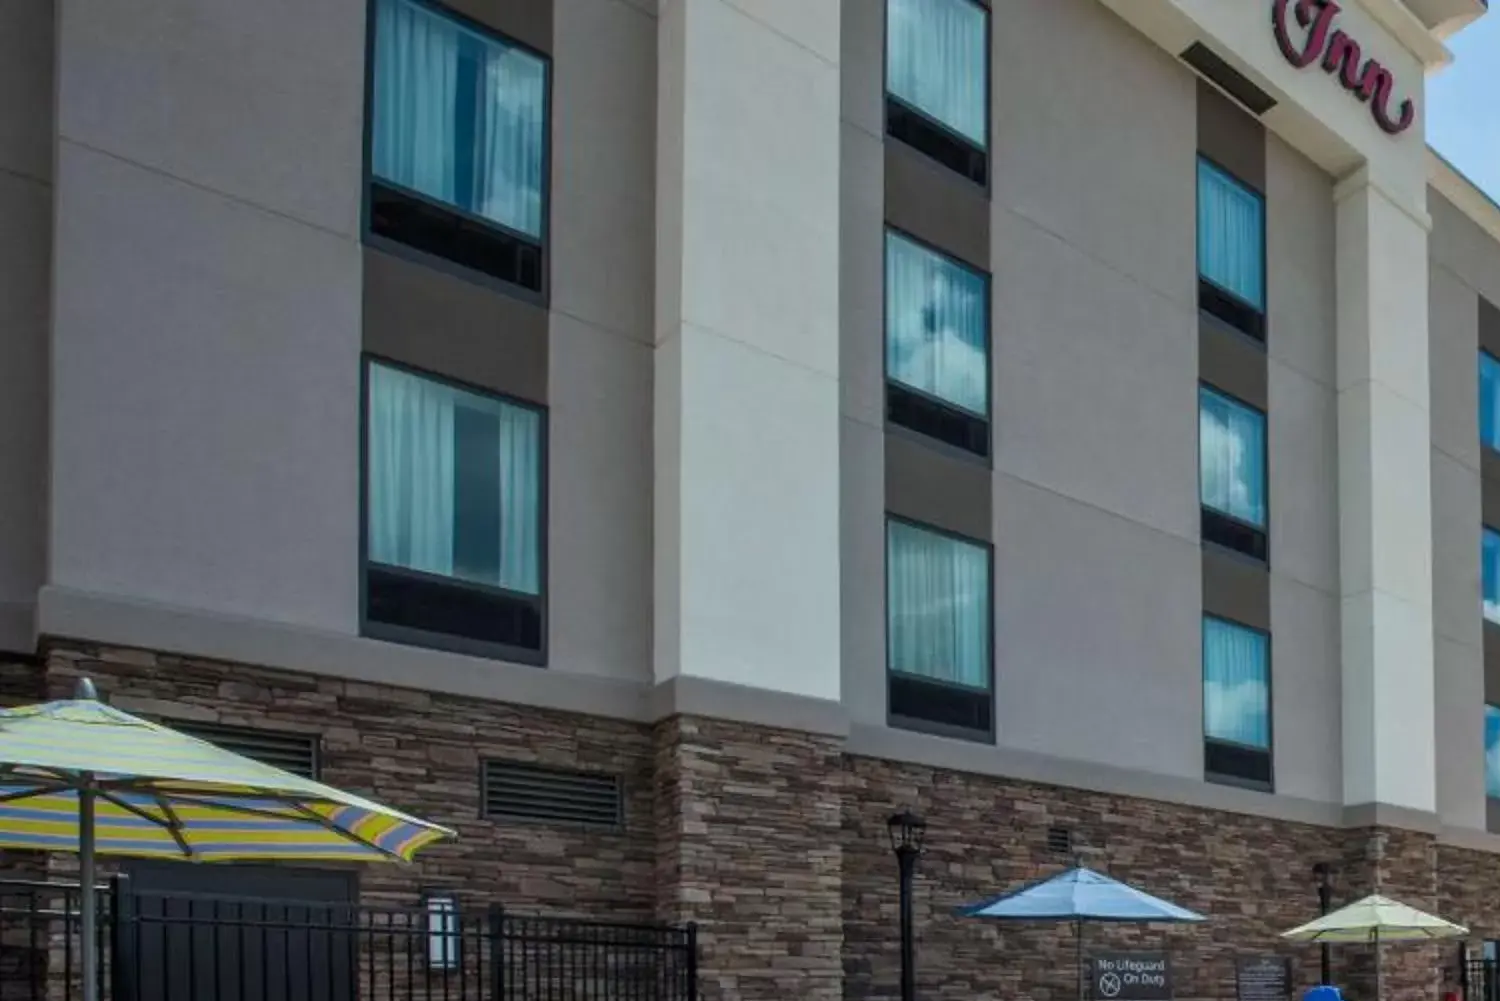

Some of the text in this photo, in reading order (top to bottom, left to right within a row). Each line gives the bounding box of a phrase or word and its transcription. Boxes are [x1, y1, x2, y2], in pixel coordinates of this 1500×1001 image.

[1271, 0, 1414, 135] Inn
[1099, 958, 1165, 973] No Lifeguard
[1123, 973, 1165, 988] On Duty
